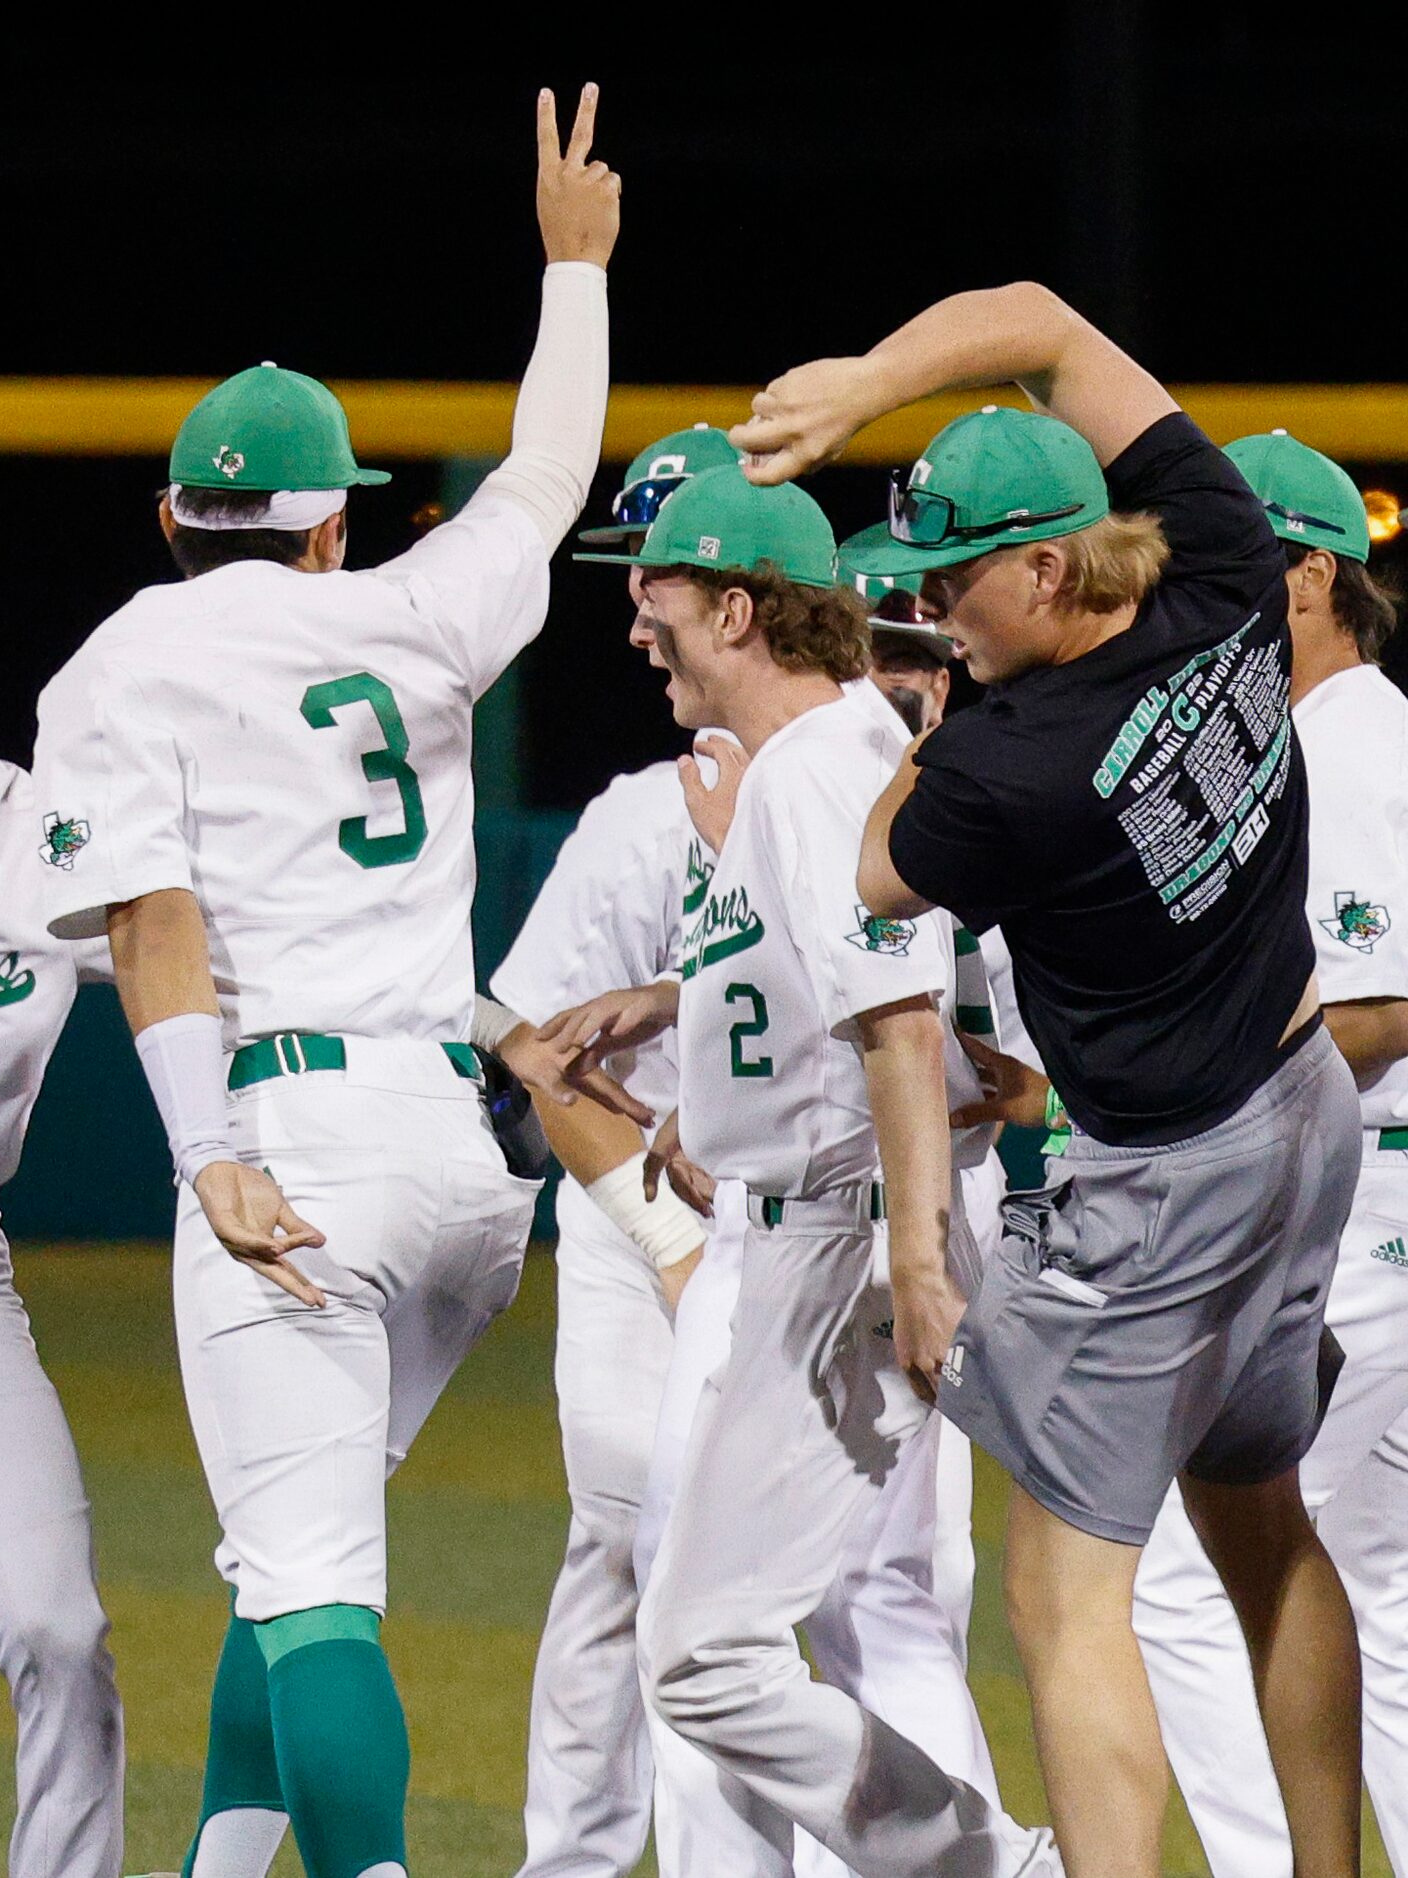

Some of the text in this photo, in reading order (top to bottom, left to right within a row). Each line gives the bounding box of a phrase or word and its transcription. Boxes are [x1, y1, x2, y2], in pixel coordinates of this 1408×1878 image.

[1092, 686, 1170, 799] CARROLL
[1129, 734, 1187, 794] BASEBALL
[1194, 642, 1243, 710] PLAYOFFS
[1172, 692, 1200, 731] C
[299, 672, 428, 869] 3
[725, 983, 774, 1078] 2
